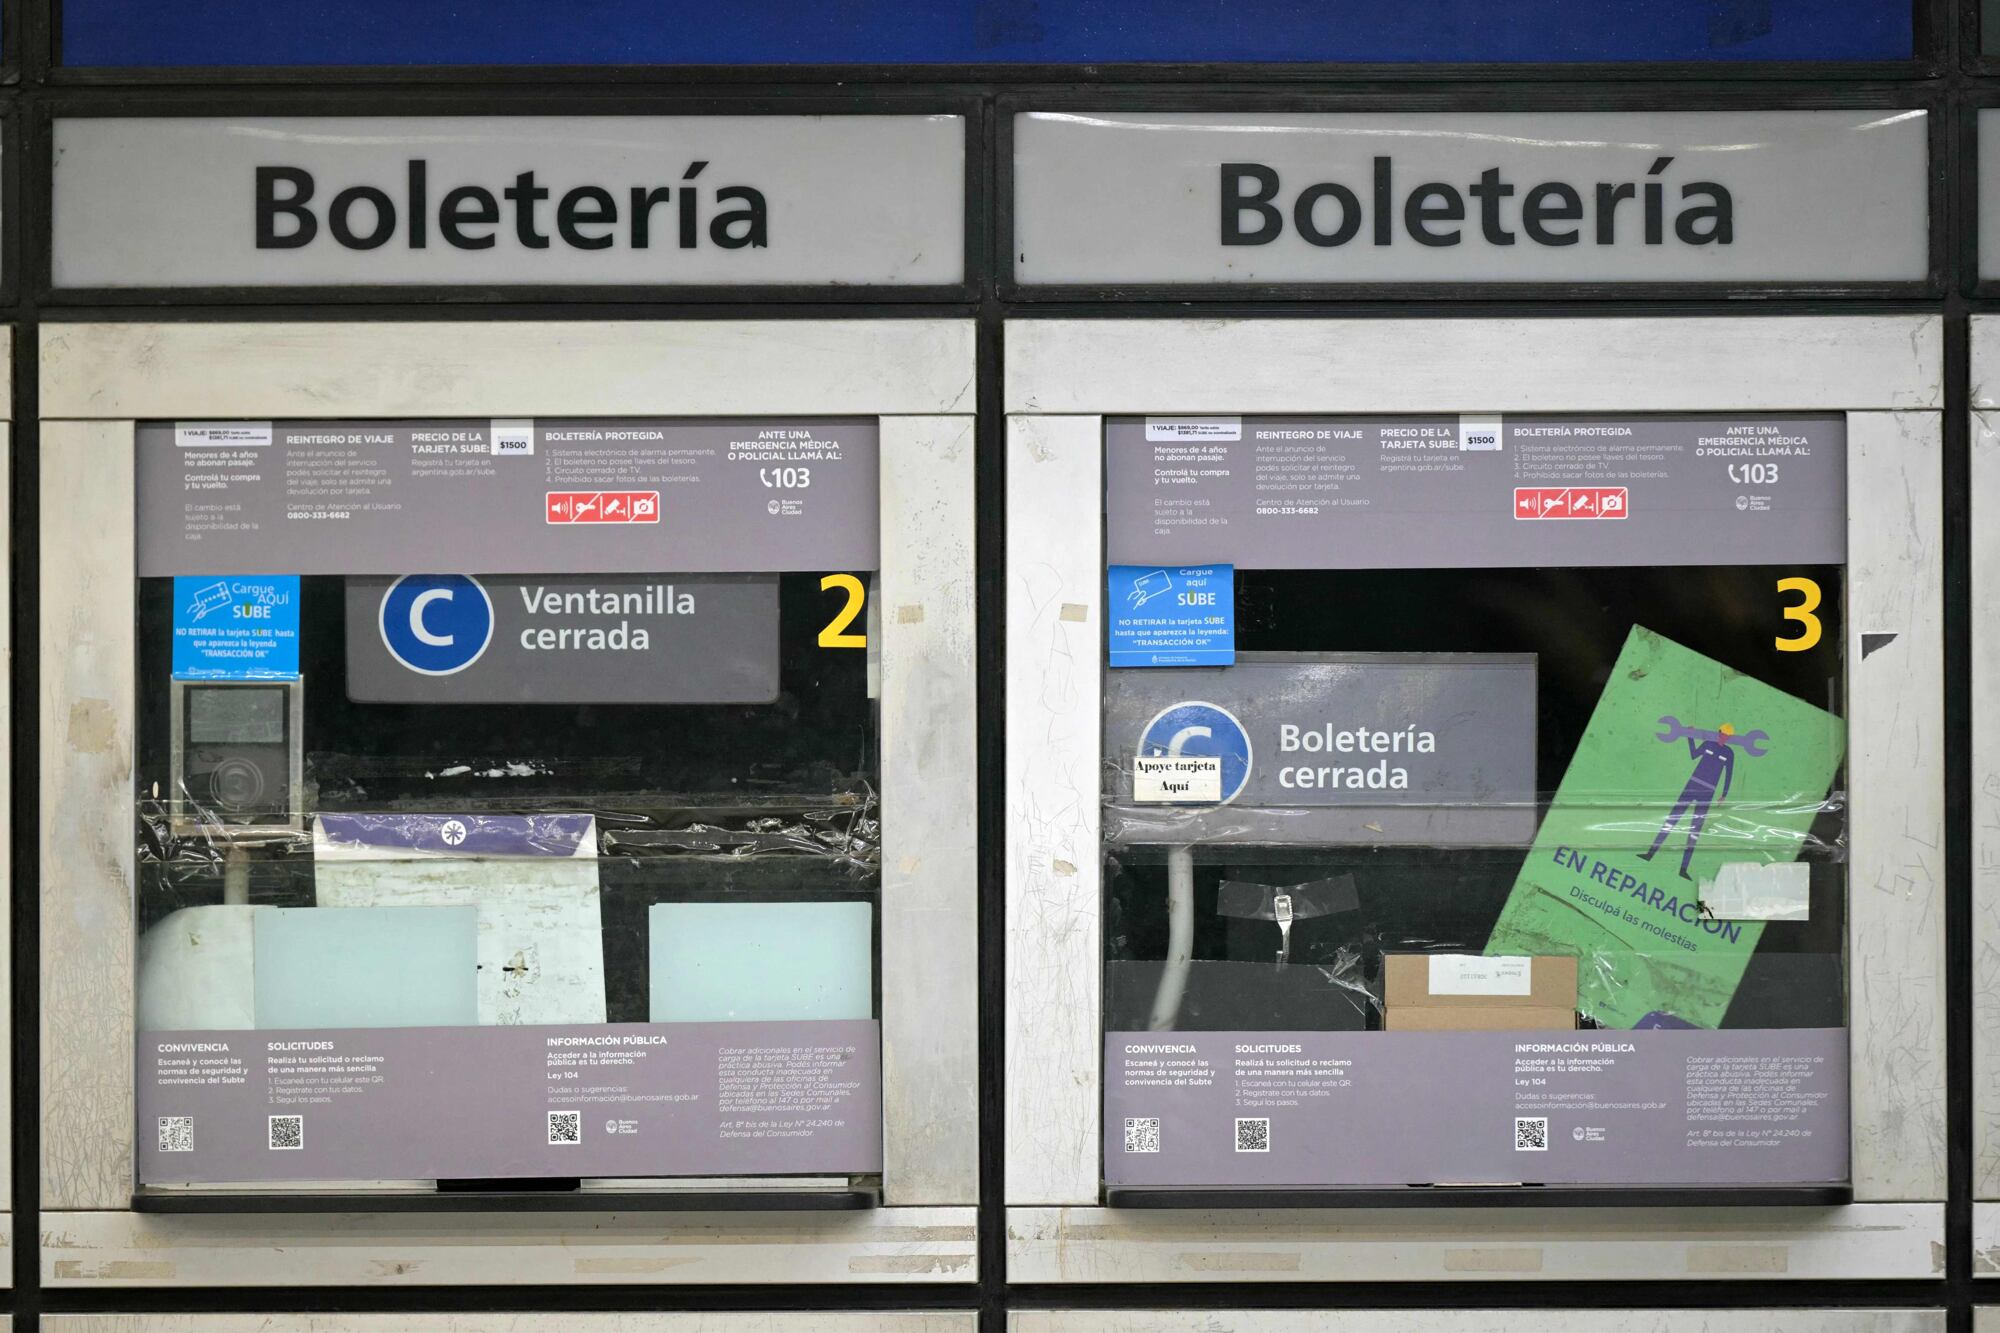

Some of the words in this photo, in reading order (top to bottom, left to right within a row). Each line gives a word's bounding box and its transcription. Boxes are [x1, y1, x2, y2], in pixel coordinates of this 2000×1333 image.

[255, 159, 768, 251] Boletería
[1220, 156, 1734, 248] Boletería
[545, 430, 603, 441] BOLETERÍA
[605, 432, 664, 440] PROTEGIDA
[758, 430, 786, 439] ANTE
[788, 430, 811, 439] UNA
[1256, 430, 1314, 440] REINTEGRO
[1317, 430, 1331, 439] DE
[1333, 430, 1363, 439] VIAJE
[1380, 428, 1418, 437] PRECIO
[1420, 428, 1435, 437] DE
[1437, 428, 1451, 437] LA
[1514, 426, 1572, 436] BOLETERÍA
[1574, 427, 1632, 436] PROTEGIDA
[1726, 426, 1754, 435] ANTE
[1756, 426, 1780, 435] UNA
[286, 435, 346, 444] REINTEGRO
[348, 435, 362, 444] DE
[364, 434, 394, 444] VIAJE
[412, 432, 450, 442] PRECIO
[452, 432, 466, 442] DE
[468, 432, 482, 441] LA
[1468, 436, 1495, 445] $1500
[1698, 437, 1765, 446] EMERGENCIA
[1768, 435, 1808, 445] MÉDICA
[412, 444, 458, 453] TARJETA
[460, 444, 490, 453] SUBE:
[500, 441, 527, 449] $1500
[730, 441, 797, 450] EMERGENCIA
[799, 440, 840, 451] MÉDICA
[1380, 440, 1426, 449] TARJETA
[1428, 440, 1458, 448] SUBE:
[728, 452, 736, 460] O
[738, 452, 786, 460] POLICIAL
[788, 450, 823, 460] LLAMÁ
[825, 451, 842, 460] AL:
[1154, 446, 1188, 454] Menores
[1189, 446, 1200, 454] de
[1208, 446, 1228, 454] años
[1696, 448, 1704, 456] O
[1706, 448, 1754, 456] POLICIAL
[1756, 446, 1792, 456] LLAMÁ
[1794, 447, 1810, 456] AL:
[1197, 454, 1224, 462] pasaje.
[771, 468, 810, 488] 103
[1154, 468, 1188, 478] Controlá
[1739, 463, 1778, 484] 103
[1171, 476, 1198, 484] vuelto.
[1256, 498, 1282, 506] Centro
[1284, 498, 1294, 506] de
[1296, 498, 1330, 506] Atención
[1331, 498, 1339, 506] al
[1340, 498, 1370, 506] Usuario
[1179, 569, 1213, 577] Cargue
[1186, 578, 1206, 587] aquí
[231, 582, 275, 596] Cargue
[257, 591, 289, 605] AQUÍ
[520, 585, 695, 615] Ventanilla
[1177, 590, 1216, 606] SUBE
[233, 603, 272, 619] SUBE
[818, 574, 868, 648] 2
[1775, 577, 1822, 652] 3
[409, 588, 454, 646] C
[1132, 618, 1167, 626] RETIRAR
[1177, 618, 1202, 626] tarjeta
[1204, 616, 1225, 625] SUBE
[176, 628, 187, 636] NO
[188, 628, 217, 636] RETIRAR
[218, 628, 225, 636] la
[226, 628, 250, 638] tarjeta
[251, 629, 272, 637] SUBE
[275, 629, 295, 637] hasta
[520, 620, 649, 650] cerrada
[1197, 628, 1229, 636] leyenda:
[193, 640, 207, 648] que
[208, 640, 240, 648] aparezca
[240, 639, 248, 647] la
[249, 639, 277, 649] leyenda
[1280, 722, 1435, 753] Boletería
[1136, 761, 1172, 774] Apoye
[1175, 760, 1216, 773] tarjeta
[1279, 759, 1408, 789] cerrada
[1161, 780, 1189, 794] Aquí
[1552, 845, 1587, 873] EN
[1590, 861, 1742, 944] REPARACN
[1570, 885, 1620, 918] Disculpá
[1622, 908, 1639, 926] las
[1641, 918, 1698, 953] molestias
[547, 1034, 620, 1046] INFORMACIÓN
[623, 1034, 667, 1045] PÚBLICA
[158, 1043, 229, 1052] CONVIVENCIA
[268, 1041, 334, 1051] SOLICITUDES
[1125, 1044, 1196, 1054] CONVIVENCIA
[1235, 1044, 1302, 1053] SOLICITUDES
[1515, 1042, 1589, 1052] INFORMACIÓN
[1591, 1042, 1635, 1052] PÚBLICA
[1125, 1059, 1158, 1067] Escaneá
[1166, 1059, 1196, 1067] conocé
[1515, 1058, 1548, 1066] Acceder
[1168, 1068, 1208, 1077] seguridad
[1235, 1068, 1246, 1076] de
[1296, 1068, 1312, 1076] más
[1314, 1068, 1344, 1076] sencilla
[1515, 1065, 1545, 1073] pública
[1125, 1078, 1172, 1086] convivencia
[1174, 1078, 1187, 1086] del
[1188, 1078, 1212, 1086] Subte
